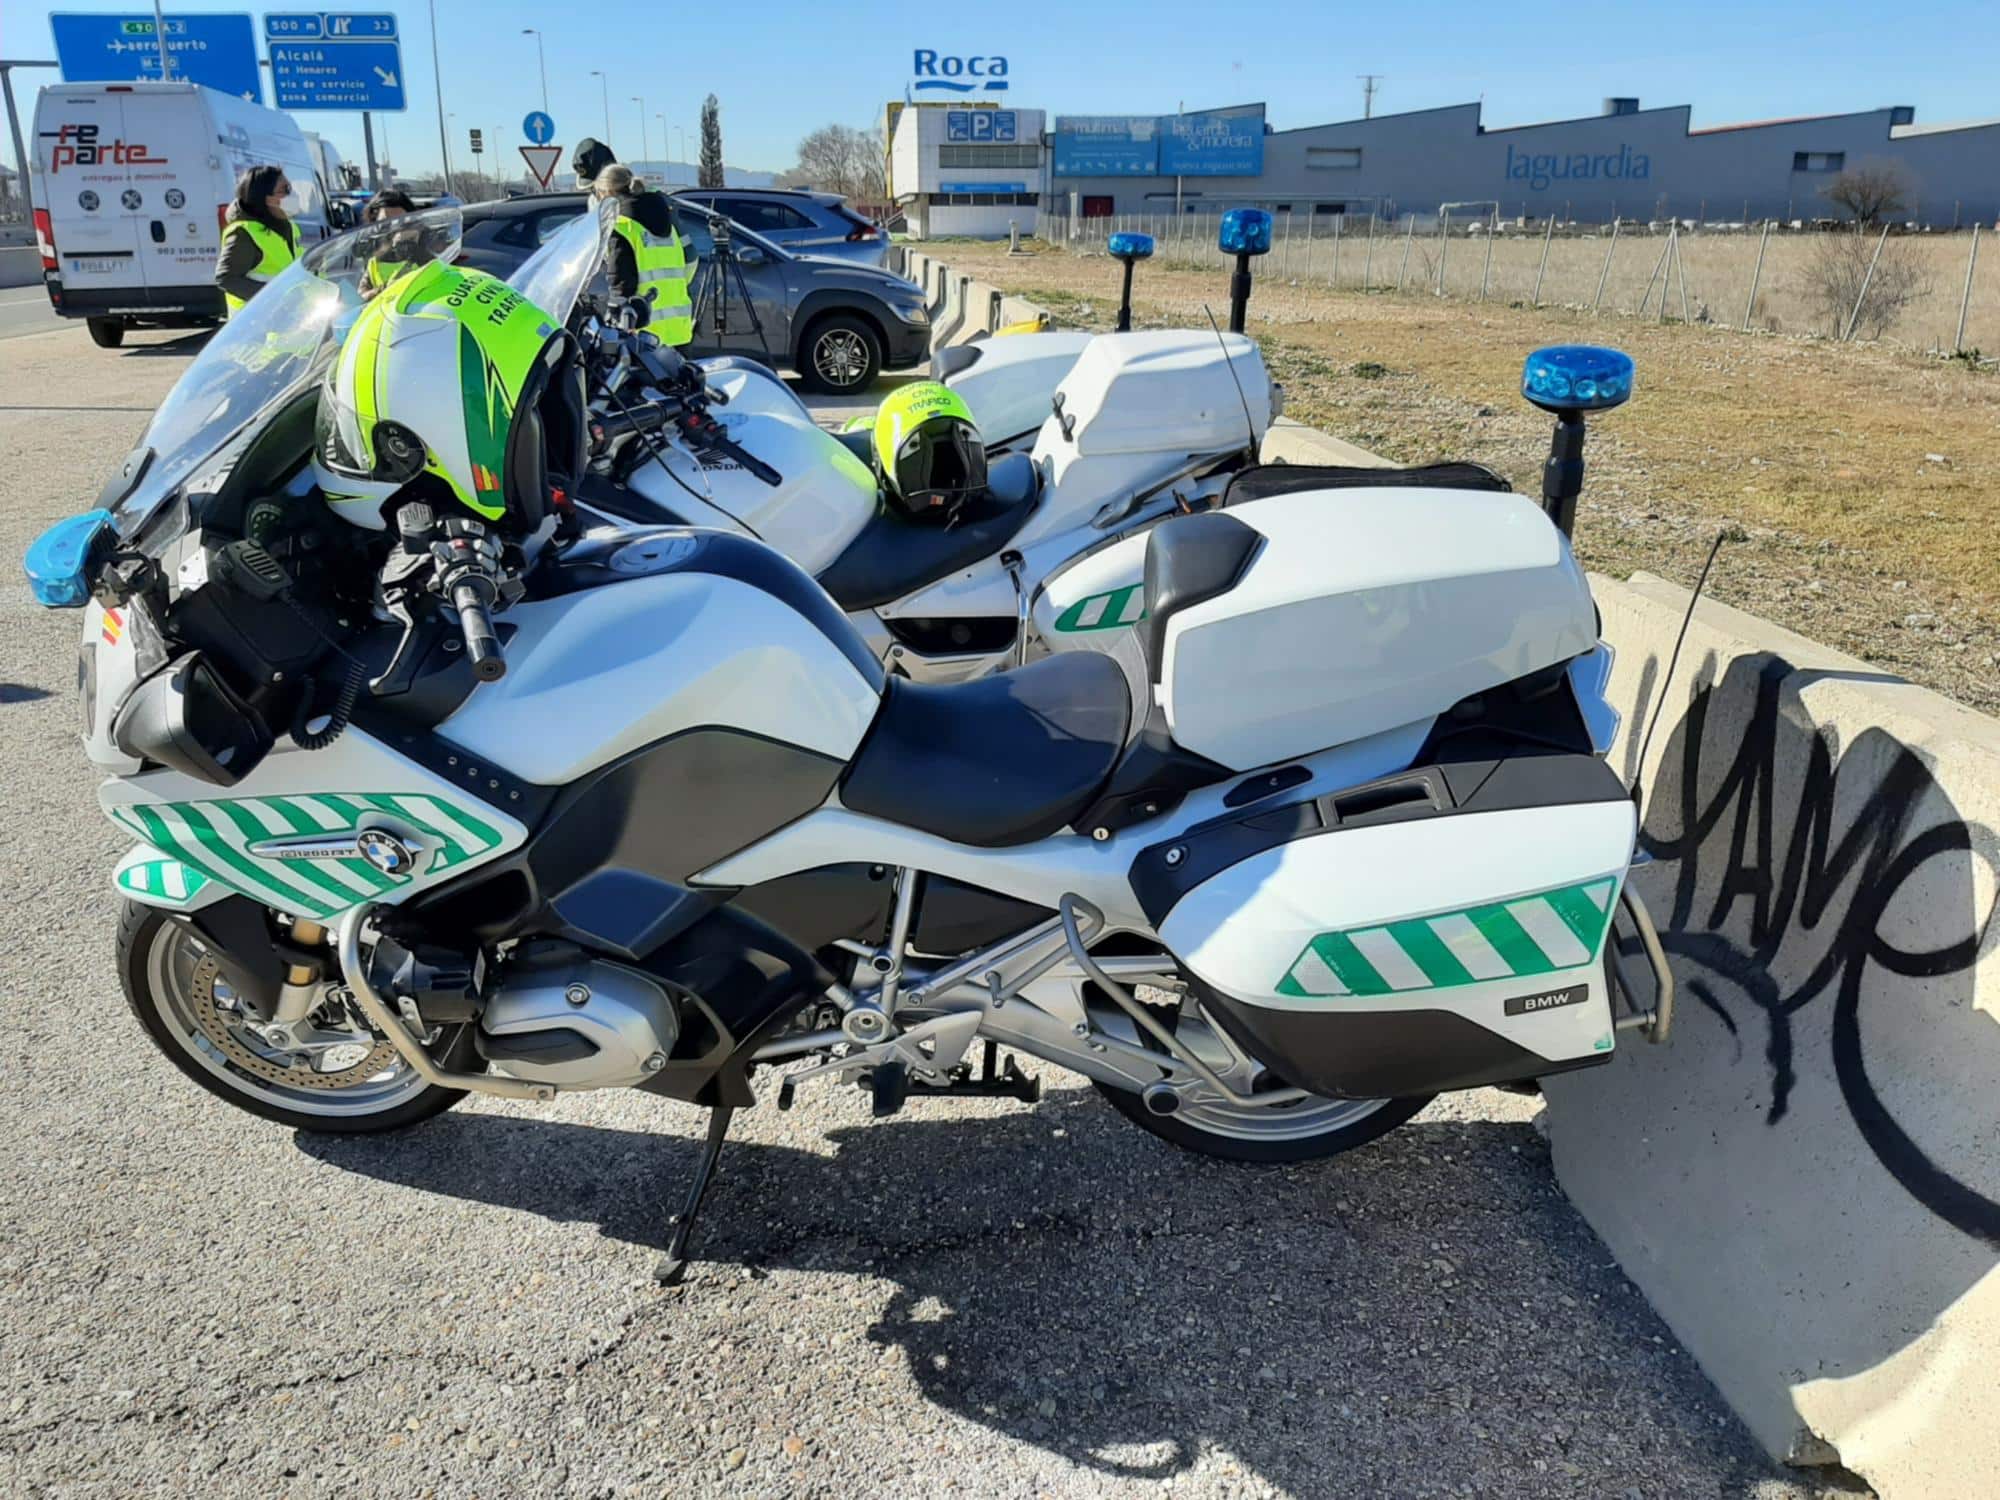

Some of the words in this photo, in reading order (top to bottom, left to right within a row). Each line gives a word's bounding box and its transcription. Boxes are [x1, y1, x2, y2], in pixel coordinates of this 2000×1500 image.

[272, 21, 299, 31] 500
[306, 22, 317, 30] m
[373, 20, 391, 31] 33
[127, 39, 208, 52] aerouerto
[914, 48, 1008, 77] Roca
[973, 114, 990, 137] P
[1505, 143, 1650, 192] laguardia
[1524, 992, 1570, 1011] BMW
